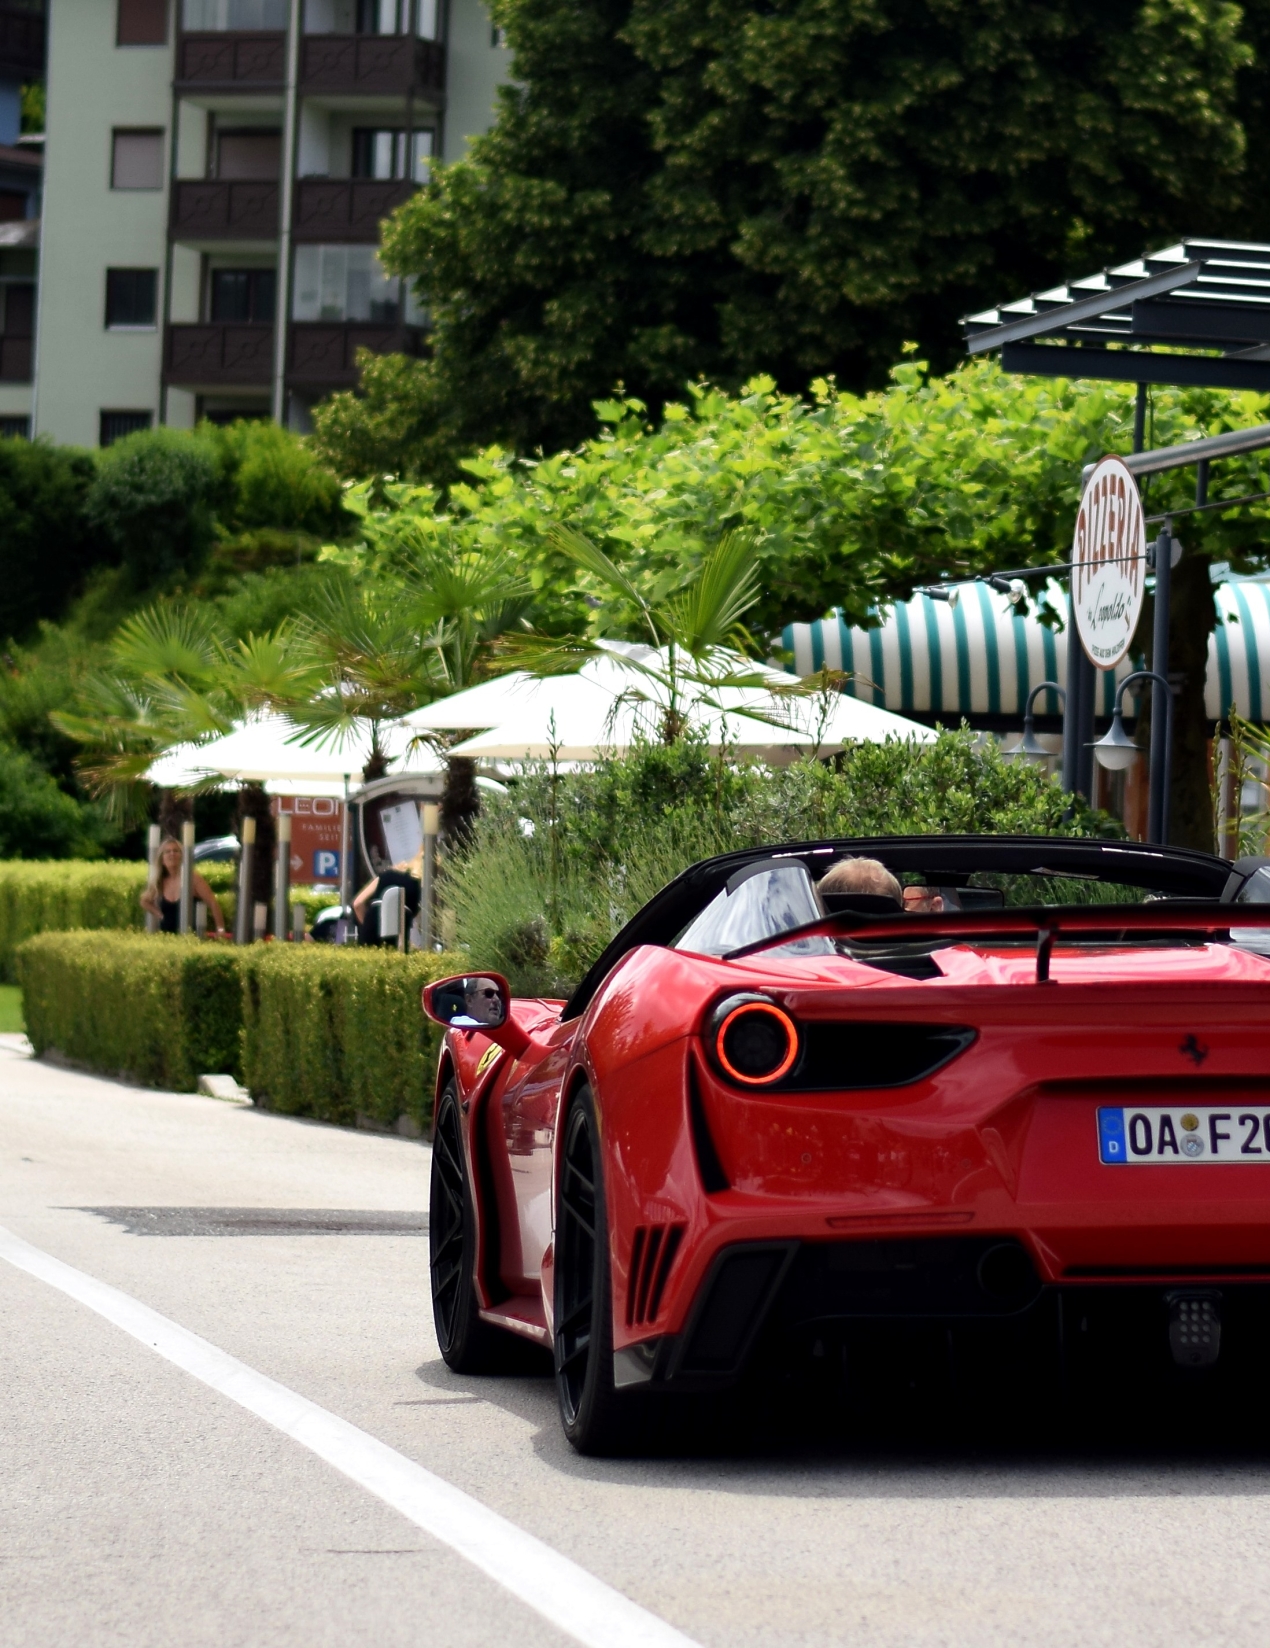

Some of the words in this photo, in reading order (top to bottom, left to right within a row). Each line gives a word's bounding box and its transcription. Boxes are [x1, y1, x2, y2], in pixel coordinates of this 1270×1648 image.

[1078, 473, 1142, 605] PIZZERIA
[1108, 1141, 1119, 1153] D
[1128, 1113, 1179, 1155] OA
